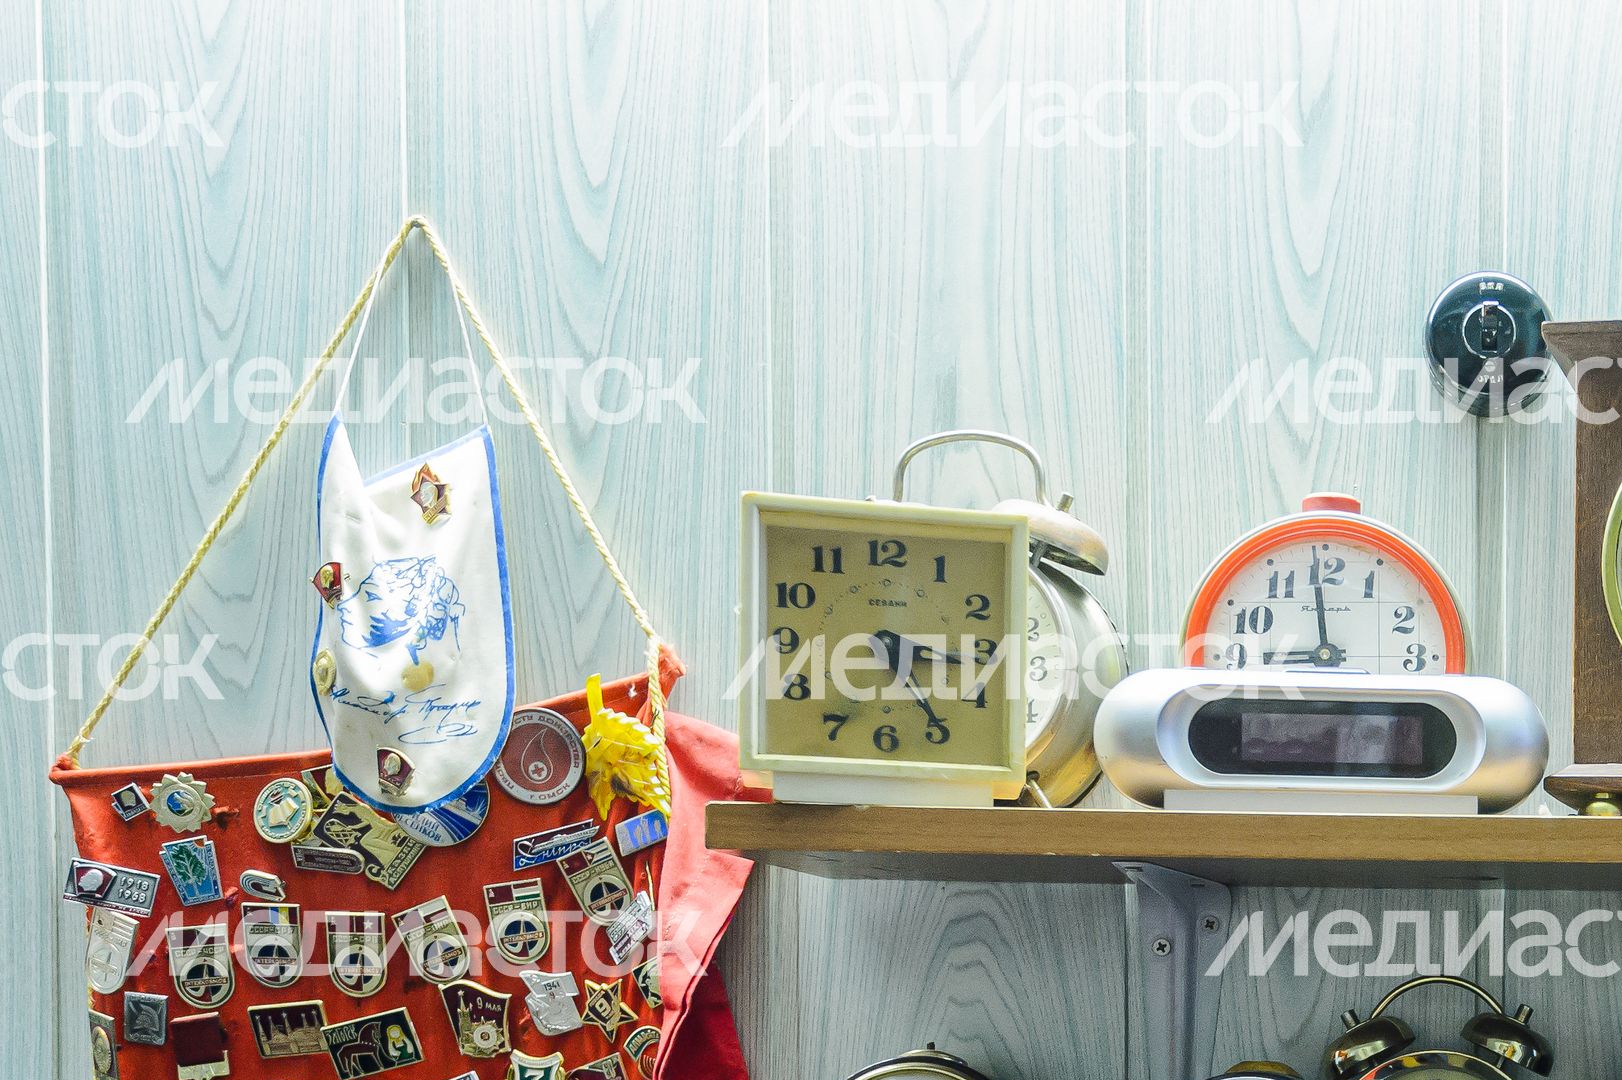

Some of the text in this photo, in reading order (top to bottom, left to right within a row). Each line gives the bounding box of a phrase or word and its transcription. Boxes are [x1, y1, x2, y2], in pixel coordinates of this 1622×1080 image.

[811, 545, 845, 574] 11
[867, 539, 908, 568] 12
[933, 555, 948, 583] 1
[1308, 557, 1345, 586] 12
[775, 582, 816, 609] 10
[1267, 570, 1295, 598] 11
[1363, 570, 1375, 598] 1
[964, 594, 991, 621] 2
[1233, 605, 1274, 635] 10
[1392, 605, 1415, 635] 2
[823, 712, 849, 741] 7
[873, 725, 899, 752] 6
[119, 889, 146, 902] 1968
[121, 877, 149, 890] 1918
[543, 981, 560, 991] 1941
[476, 997, 482, 1009] 9
